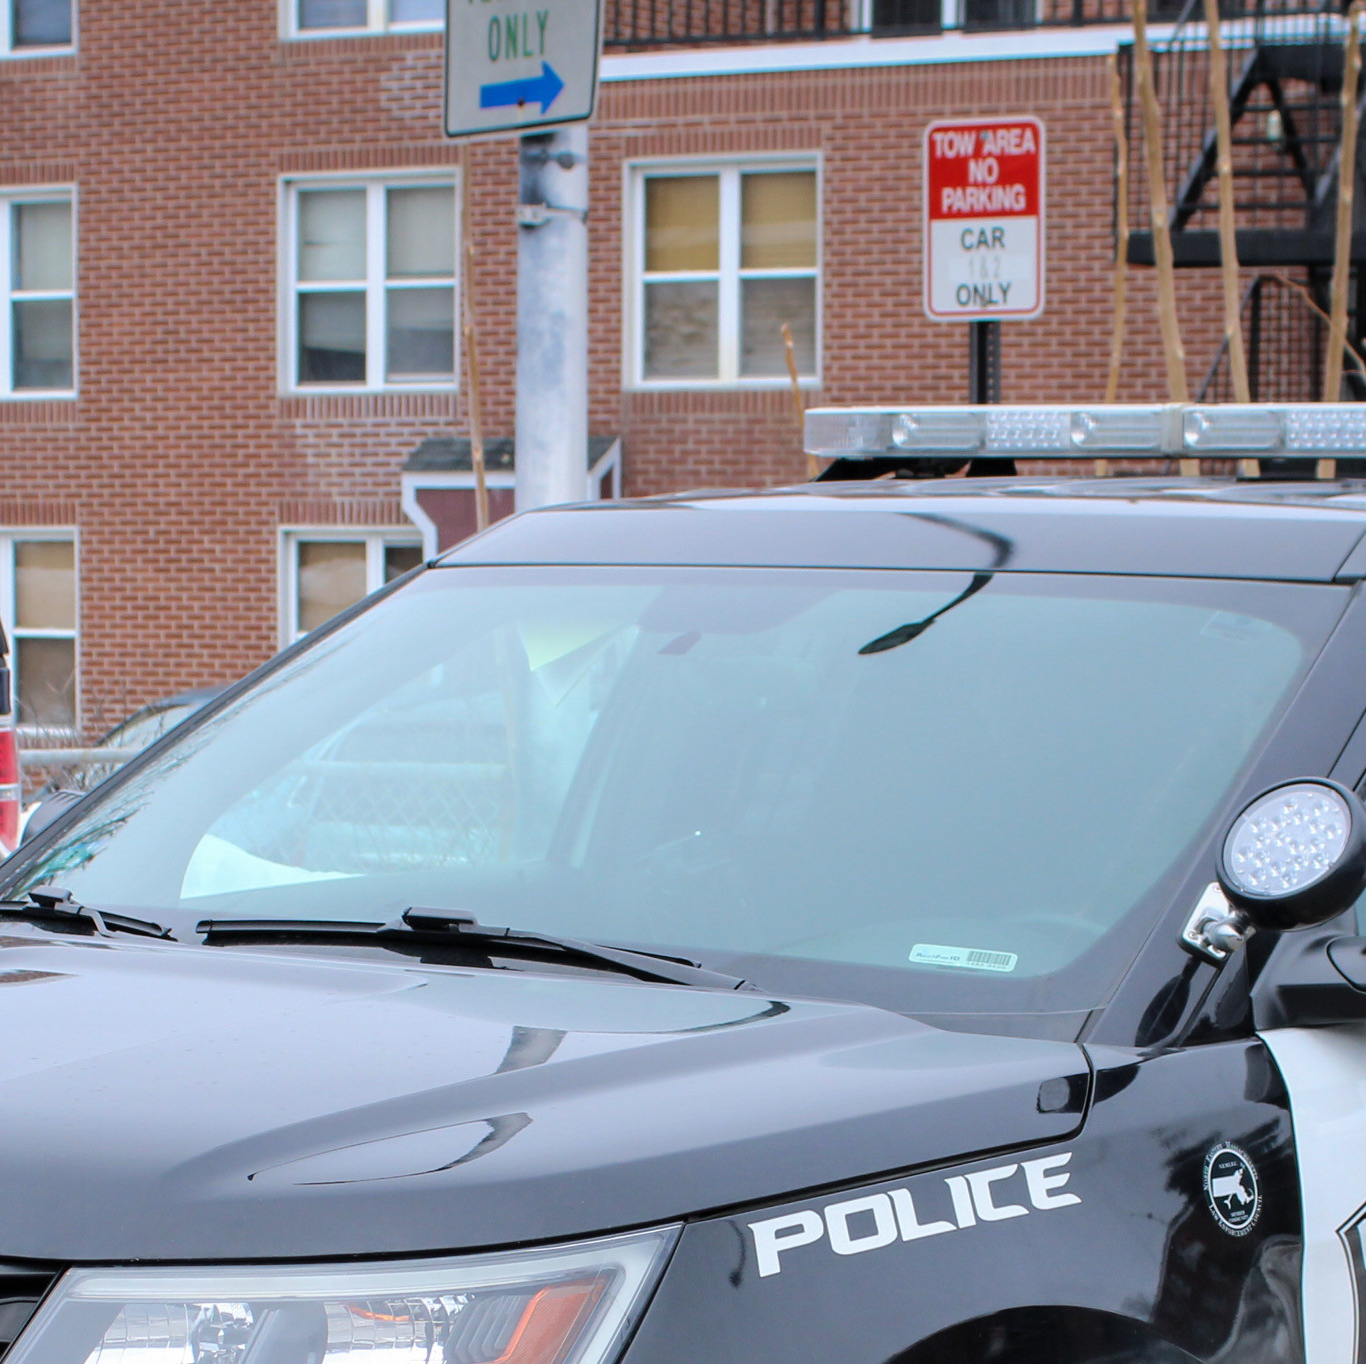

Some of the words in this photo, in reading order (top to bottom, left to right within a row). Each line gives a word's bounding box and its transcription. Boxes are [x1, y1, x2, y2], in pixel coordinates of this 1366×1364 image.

[488, 9, 549, 62] ONLY
[932, 131, 977, 158] TOW
[982, 128, 1035, 156] AREA
[968, 157, 999, 185] NO
[941, 184, 1026, 213] PARKING
[961, 227, 1005, 250] CAR
[956, 282, 1012, 307] ONLY
[747, 1152, 1083, 1278] POLICE
